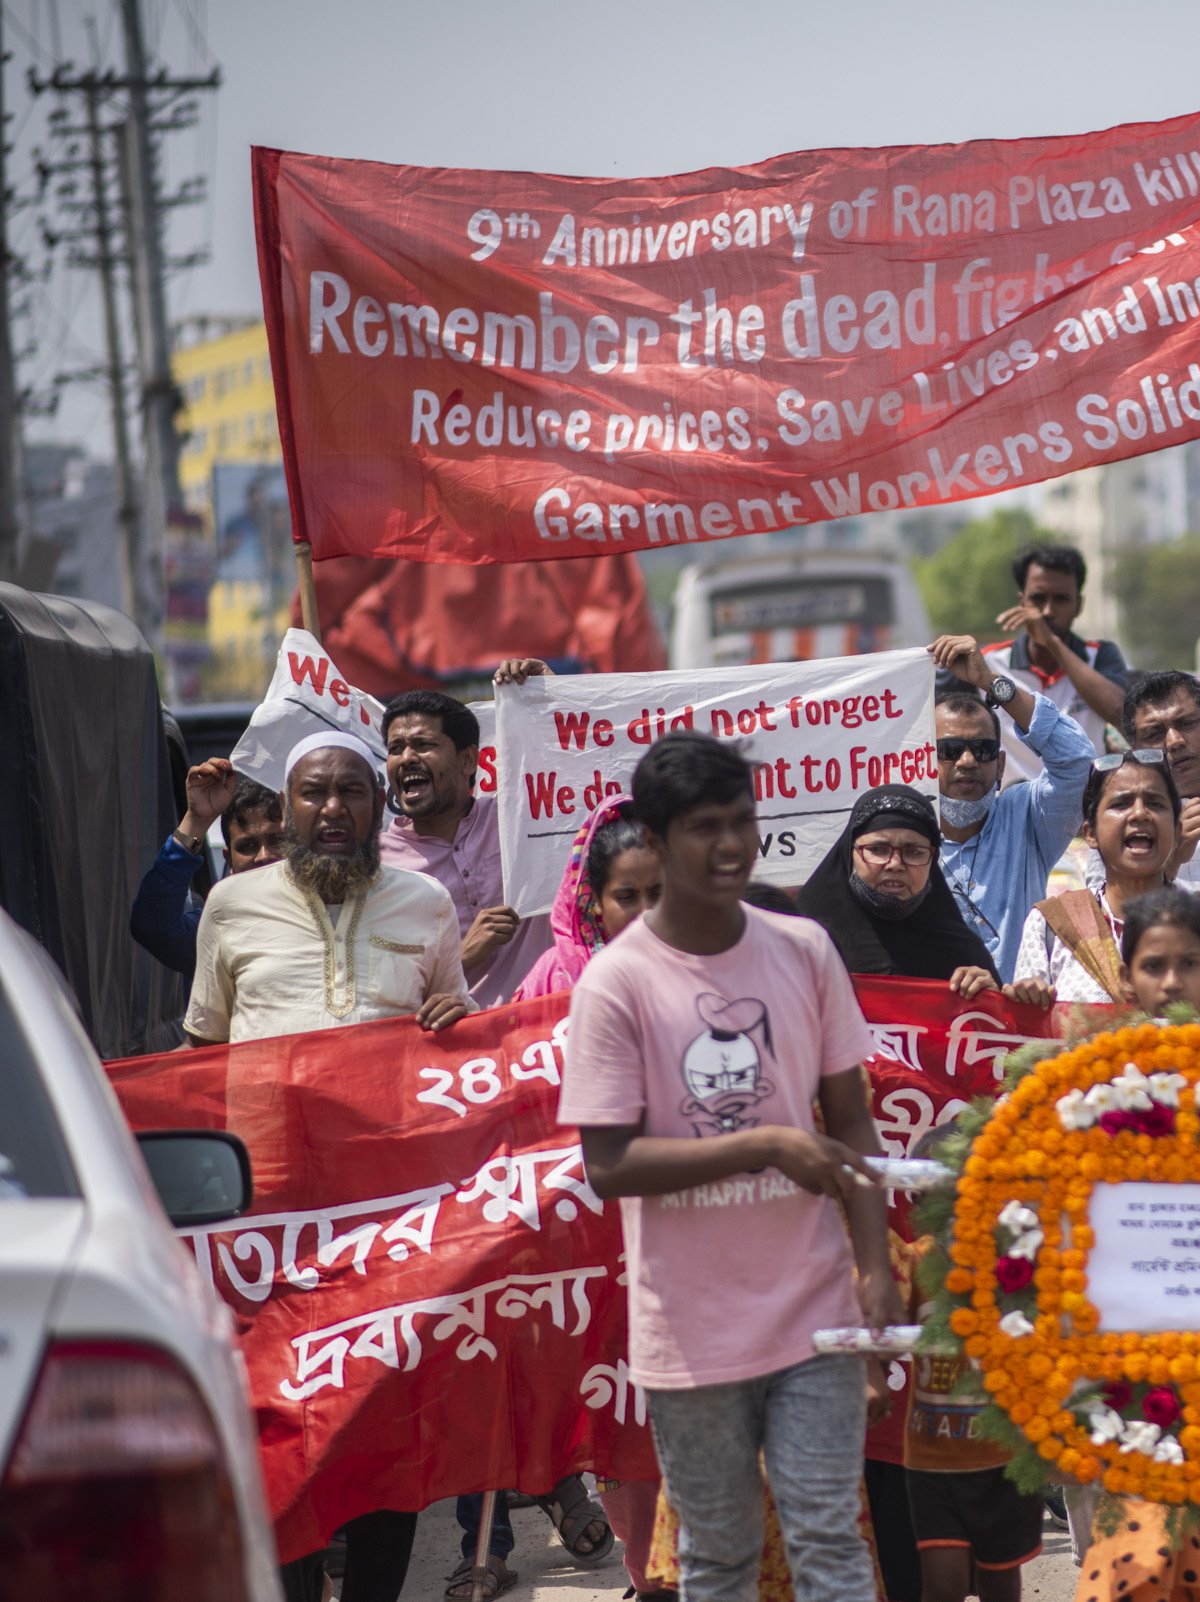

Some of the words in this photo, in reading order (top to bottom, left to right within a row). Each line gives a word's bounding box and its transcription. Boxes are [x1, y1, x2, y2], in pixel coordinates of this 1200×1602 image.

[467, 208, 541, 261] 9th
[541, 202, 814, 268] Anniversary
[829, 188, 878, 239] of
[893, 184, 996, 237] Rana
[1008, 172, 1131, 229] Plaza
[309, 270, 660, 374] Remember
[670, 287, 765, 369] the
[411, 389, 591, 451] Reduce
[776, 388, 905, 446] Save
[533, 487, 809, 544] Garment
[810, 418, 1073, 519] Workers
[287, 651, 350, 706] We
[553, 710, 615, 750] We
[627, 705, 694, 744] did
[710, 700, 778, 738] not
[785, 688, 904, 729] forget
[525, 771, 575, 820] We
[800, 754, 840, 793] to
[849, 746, 939, 793] Forget
[416, 1057, 501, 1118] ২৪
[693, 1179, 756, 1207] HAPPY
[279, 1265, 609, 1401] দ্রব্যমূল্য
